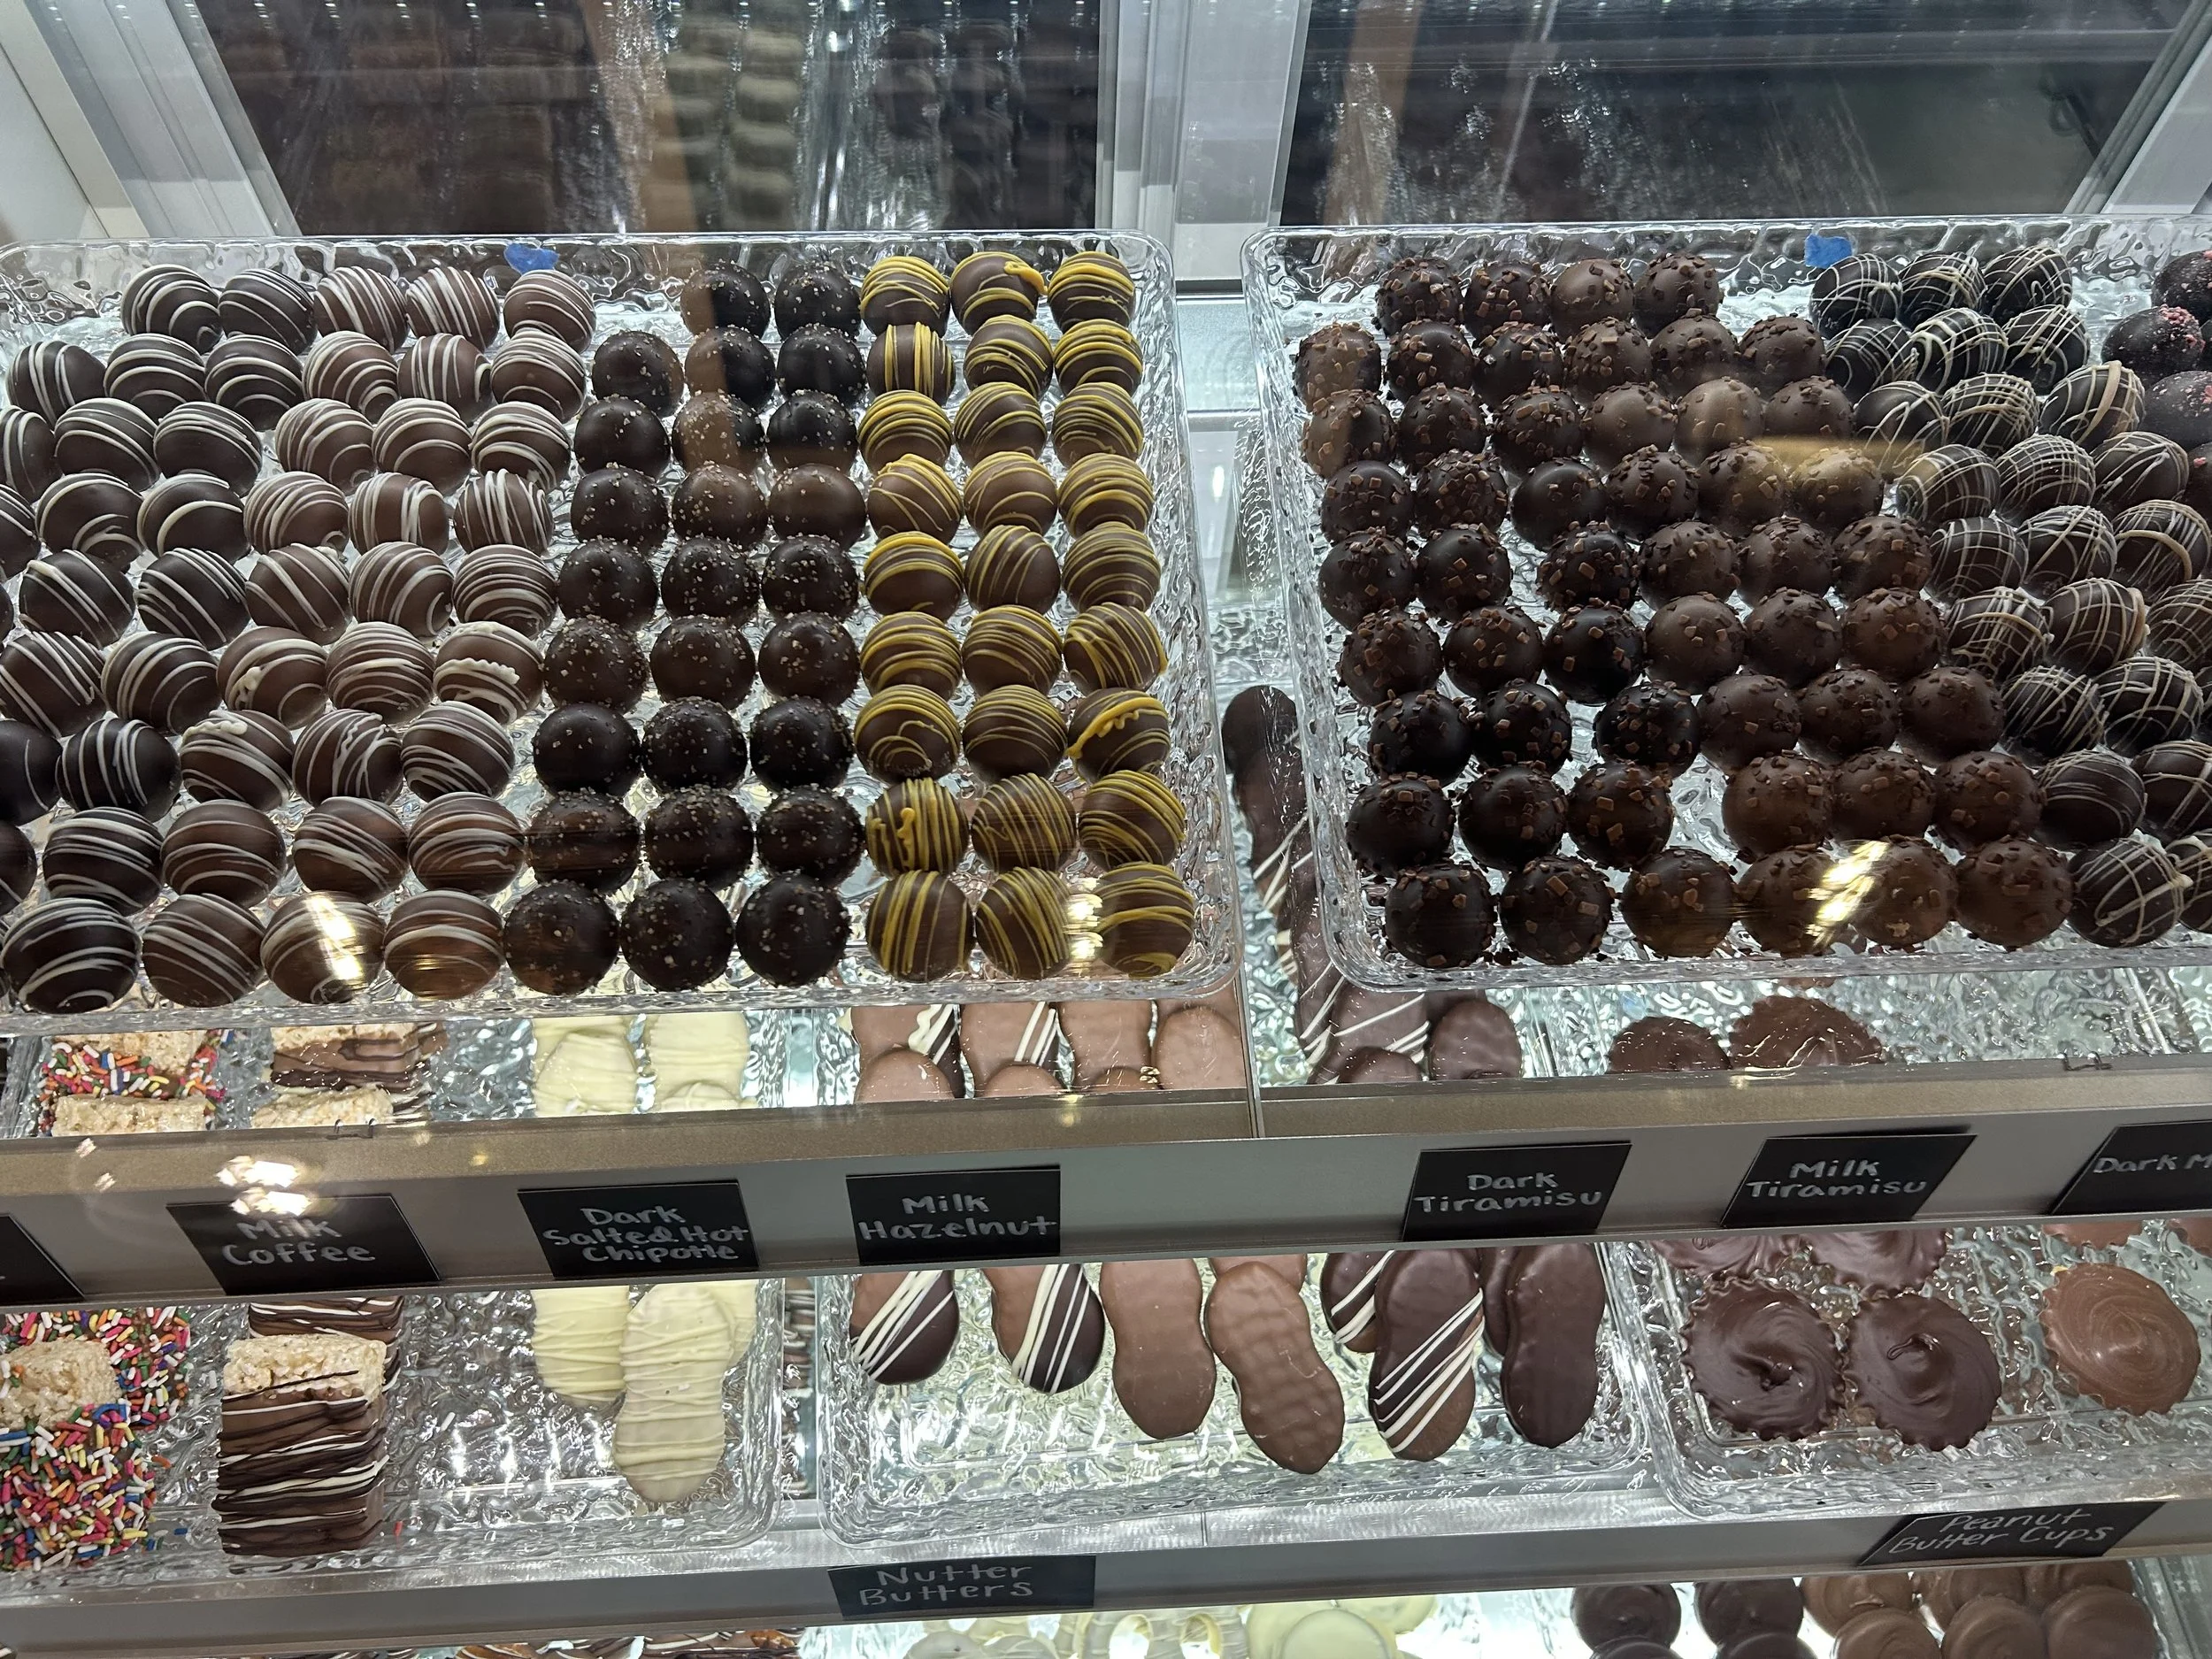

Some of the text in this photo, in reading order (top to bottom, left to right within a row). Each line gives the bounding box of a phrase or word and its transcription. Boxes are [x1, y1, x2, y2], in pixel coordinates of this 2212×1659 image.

[1789, 1159, 1881, 1179] Milk
[2093, 1154, 2178, 1173] Dark
[1467, 1171, 1559, 1190] Dark
[1745, 1179, 1928, 1198] Tiramisu
[901, 1194, 990, 1214] Milk
[1414, 1190, 1602, 1213] Tiramisu
[580, 1206, 687, 1225] Dark
[236, 1217, 342, 1239] Milk
[542, 1225, 749, 1245] Salted Hot
[857, 1216, 1058, 1240] Hazelnut
[222, 1240, 376, 1265] Coffee
[581, 1244, 739, 1263] Chipotle
[1939, 1508, 2092, 1532] Peanut
[1888, 1525, 2115, 1555] Butter Cups
[876, 1563, 1033, 1586] Nutter
[858, 1580, 1033, 1606] Butters
